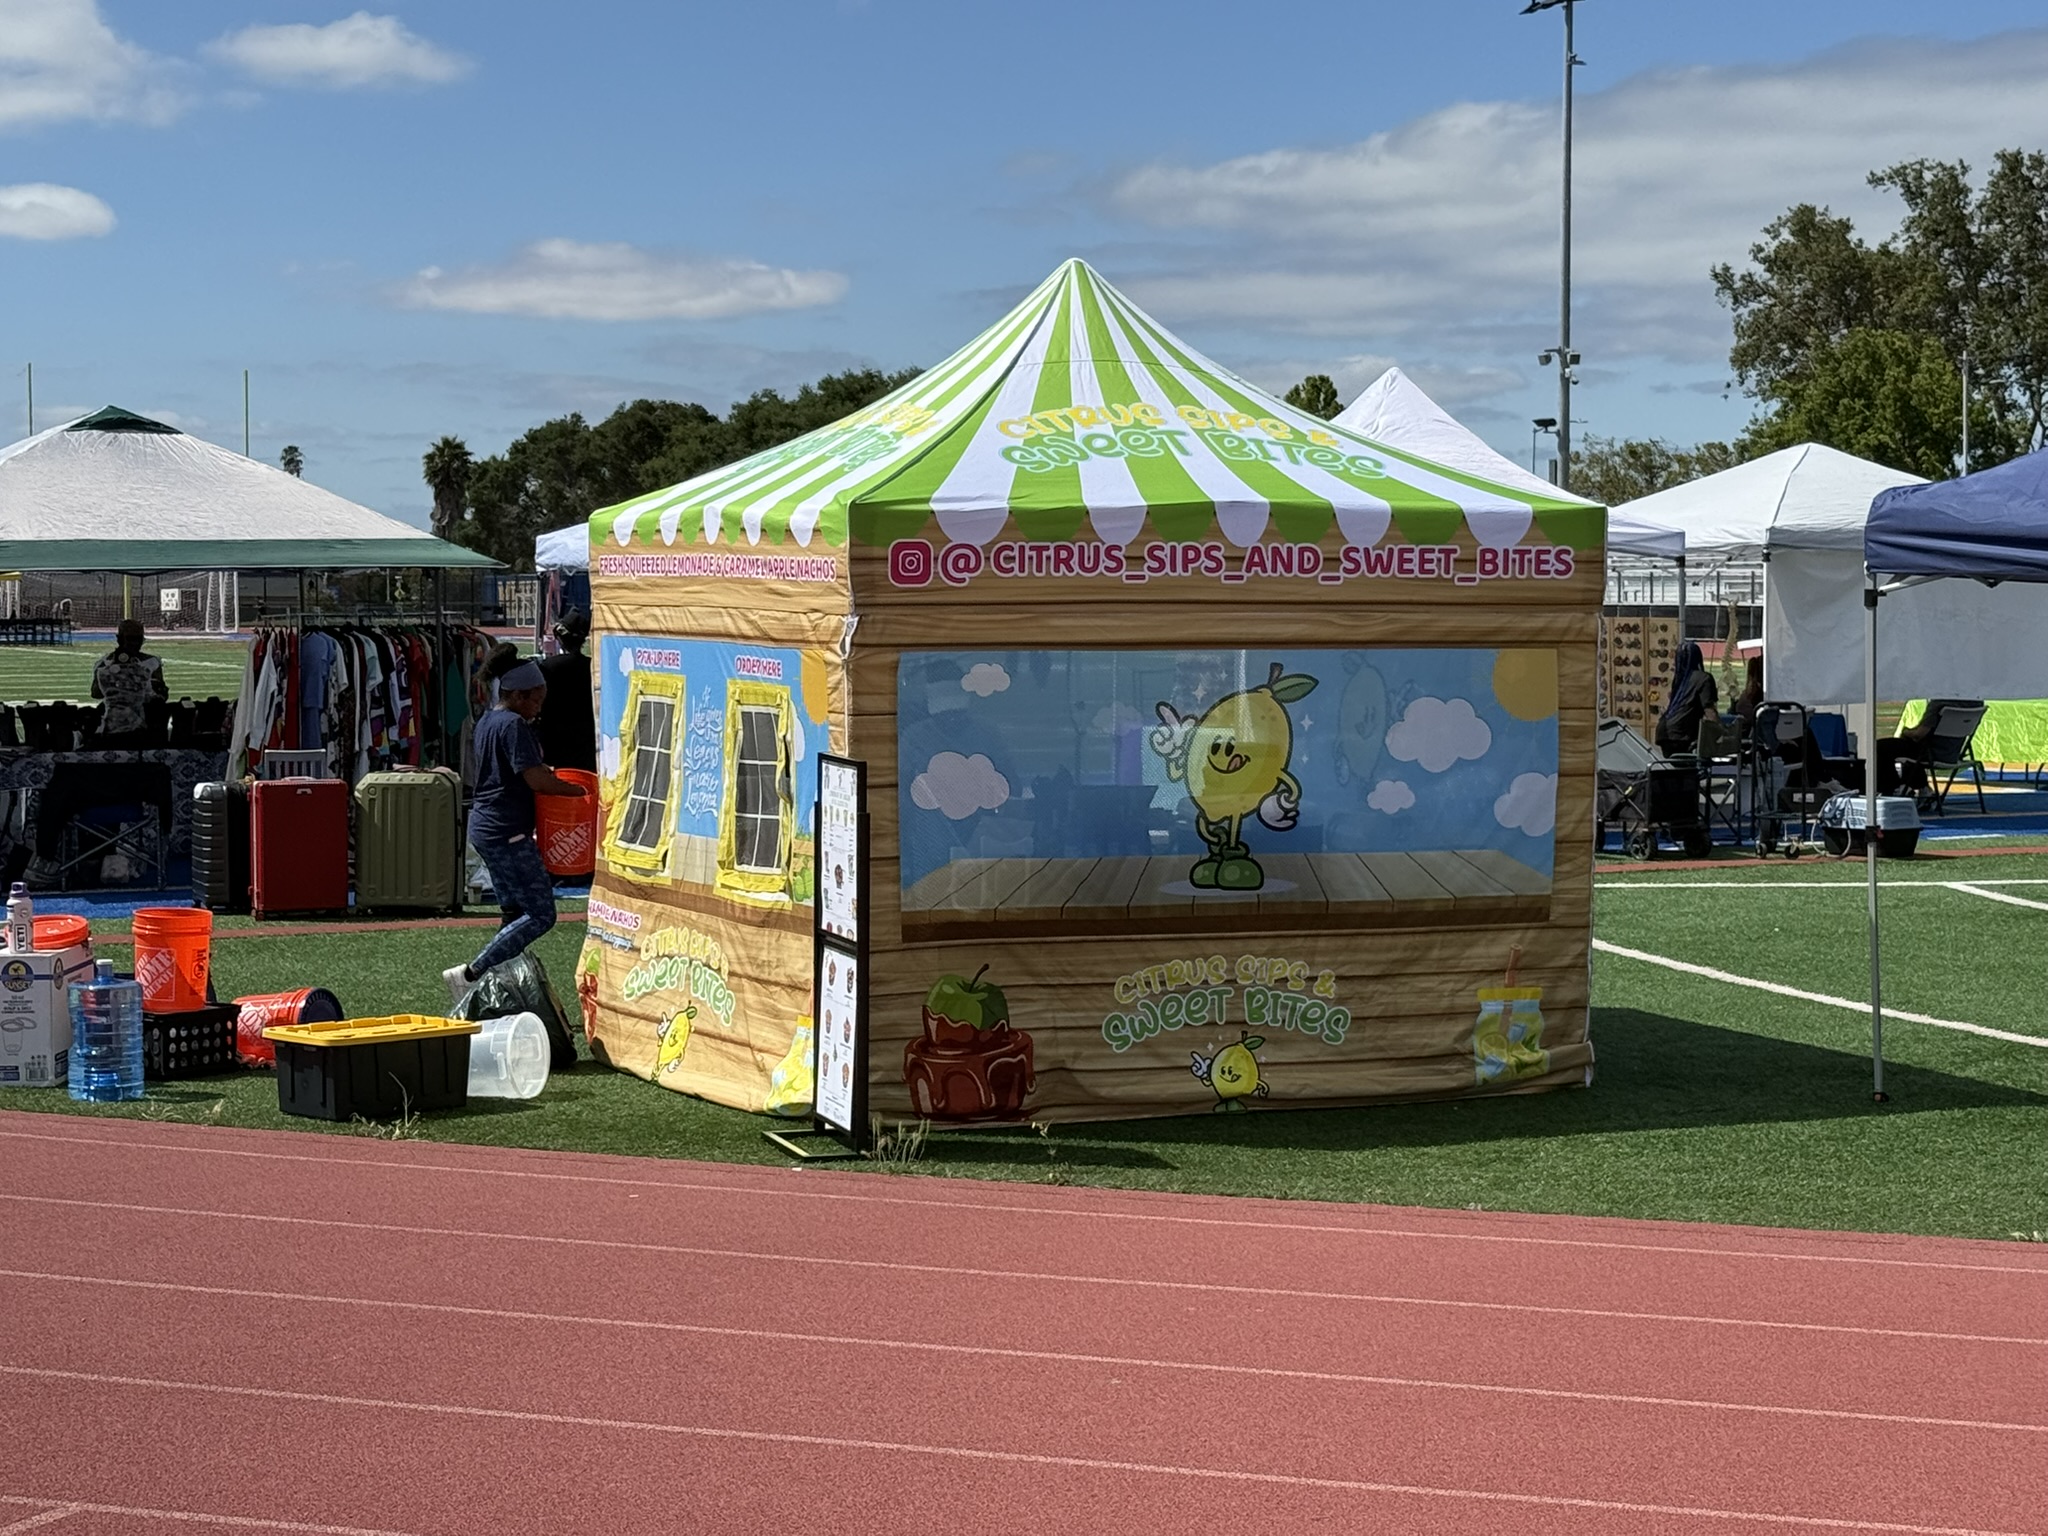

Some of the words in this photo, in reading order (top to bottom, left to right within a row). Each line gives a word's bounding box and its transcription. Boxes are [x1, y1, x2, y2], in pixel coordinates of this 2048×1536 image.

[998, 402, 1165, 439] CITRUS
[1174, 404, 1292, 441] SIPS
[599, 555, 623, 577] FRESH
[625, 555, 667, 579] SQUEEZED
[668, 554, 714, 577] LEMONADE
[724, 556, 766, 579] CARAMEL
[767, 557, 796, 580] APPLE
[796, 557, 836, 581] NACHOS
[735, 656, 761, 675] ORDER
[761, 659, 783, 678] HERE
[16, 926, 26, 950] YETI
[5, 981, 32, 991] SUNSET
[1114, 956, 1228, 1004] CITRUS
[1234, 955, 1309, 991] SIPS
[1313, 969, 1337, 998] &
[1102, 987, 1233, 1053] SWEET
[1244, 987, 1350, 1045] BITES
